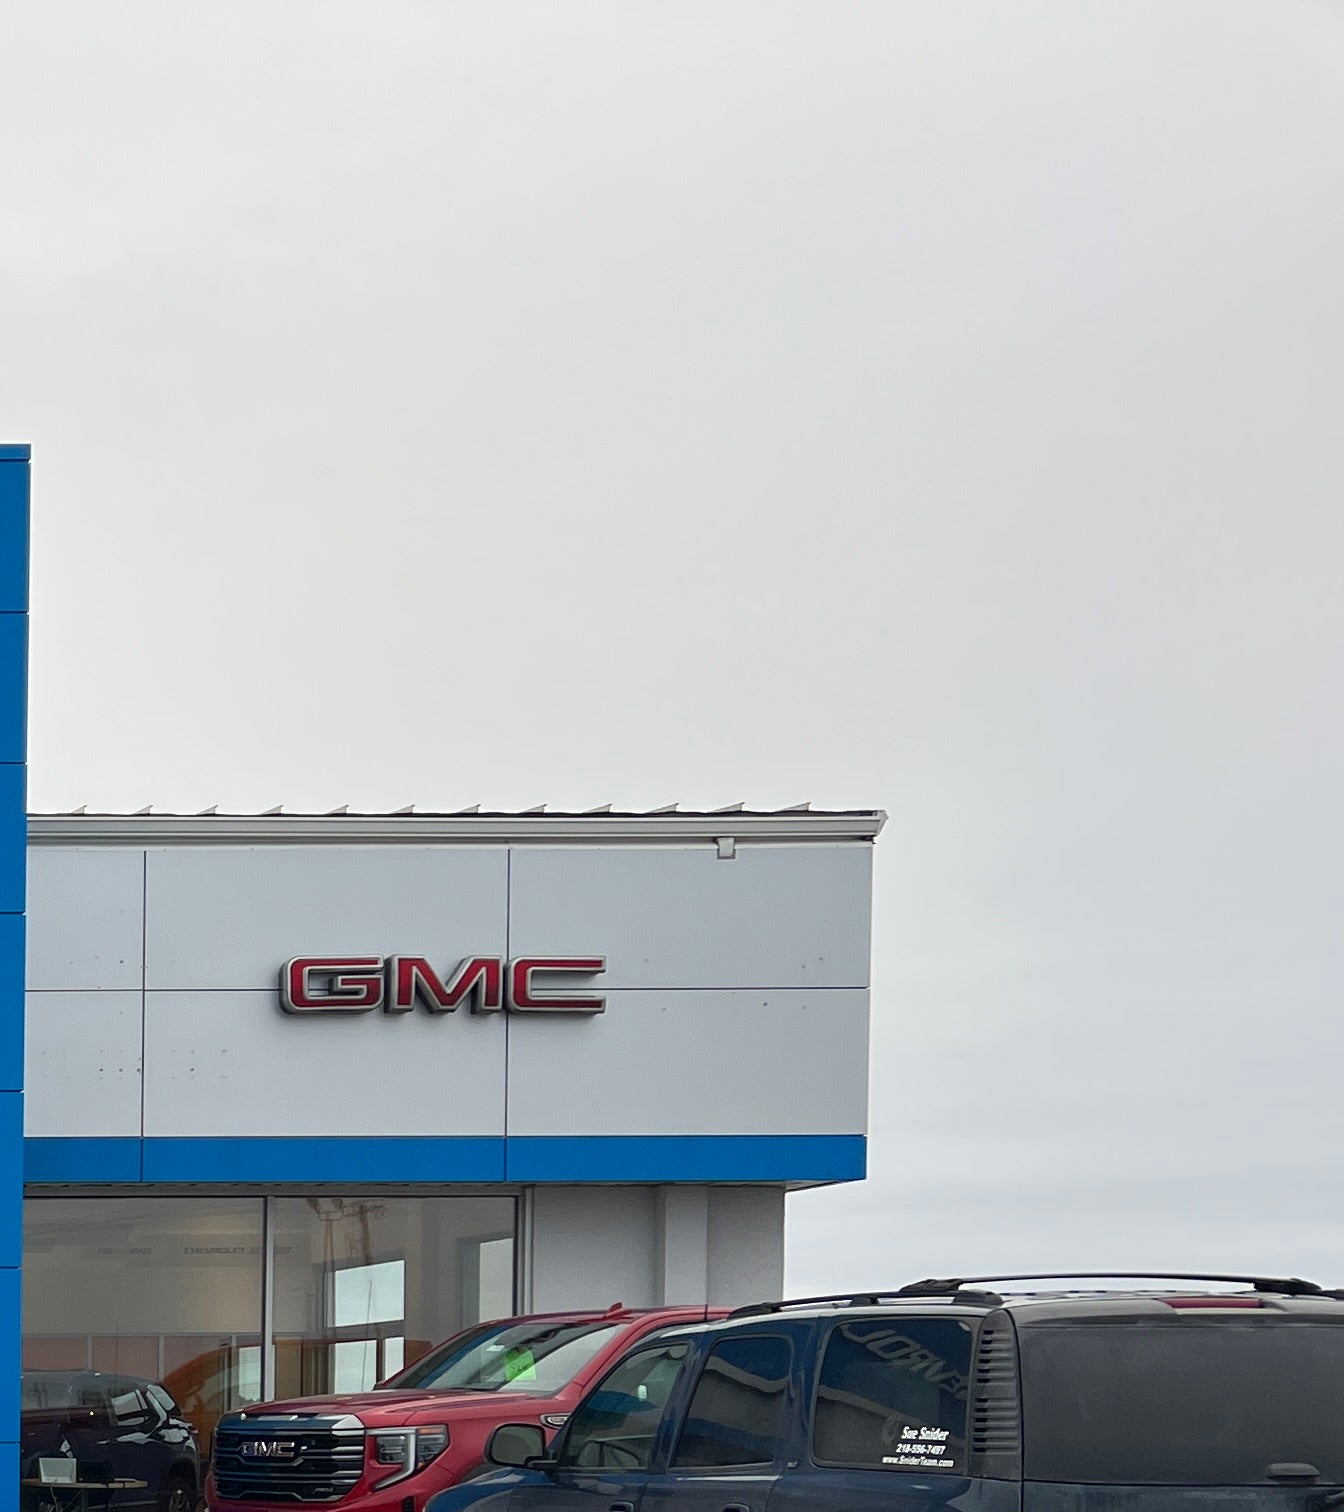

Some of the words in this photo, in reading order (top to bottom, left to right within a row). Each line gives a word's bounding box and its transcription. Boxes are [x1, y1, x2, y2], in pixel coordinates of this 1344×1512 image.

[279, 953, 607, 1015] GMC
[919, 1426, 950, 1441] Snider
[240, 1441, 296, 1458] GMC
